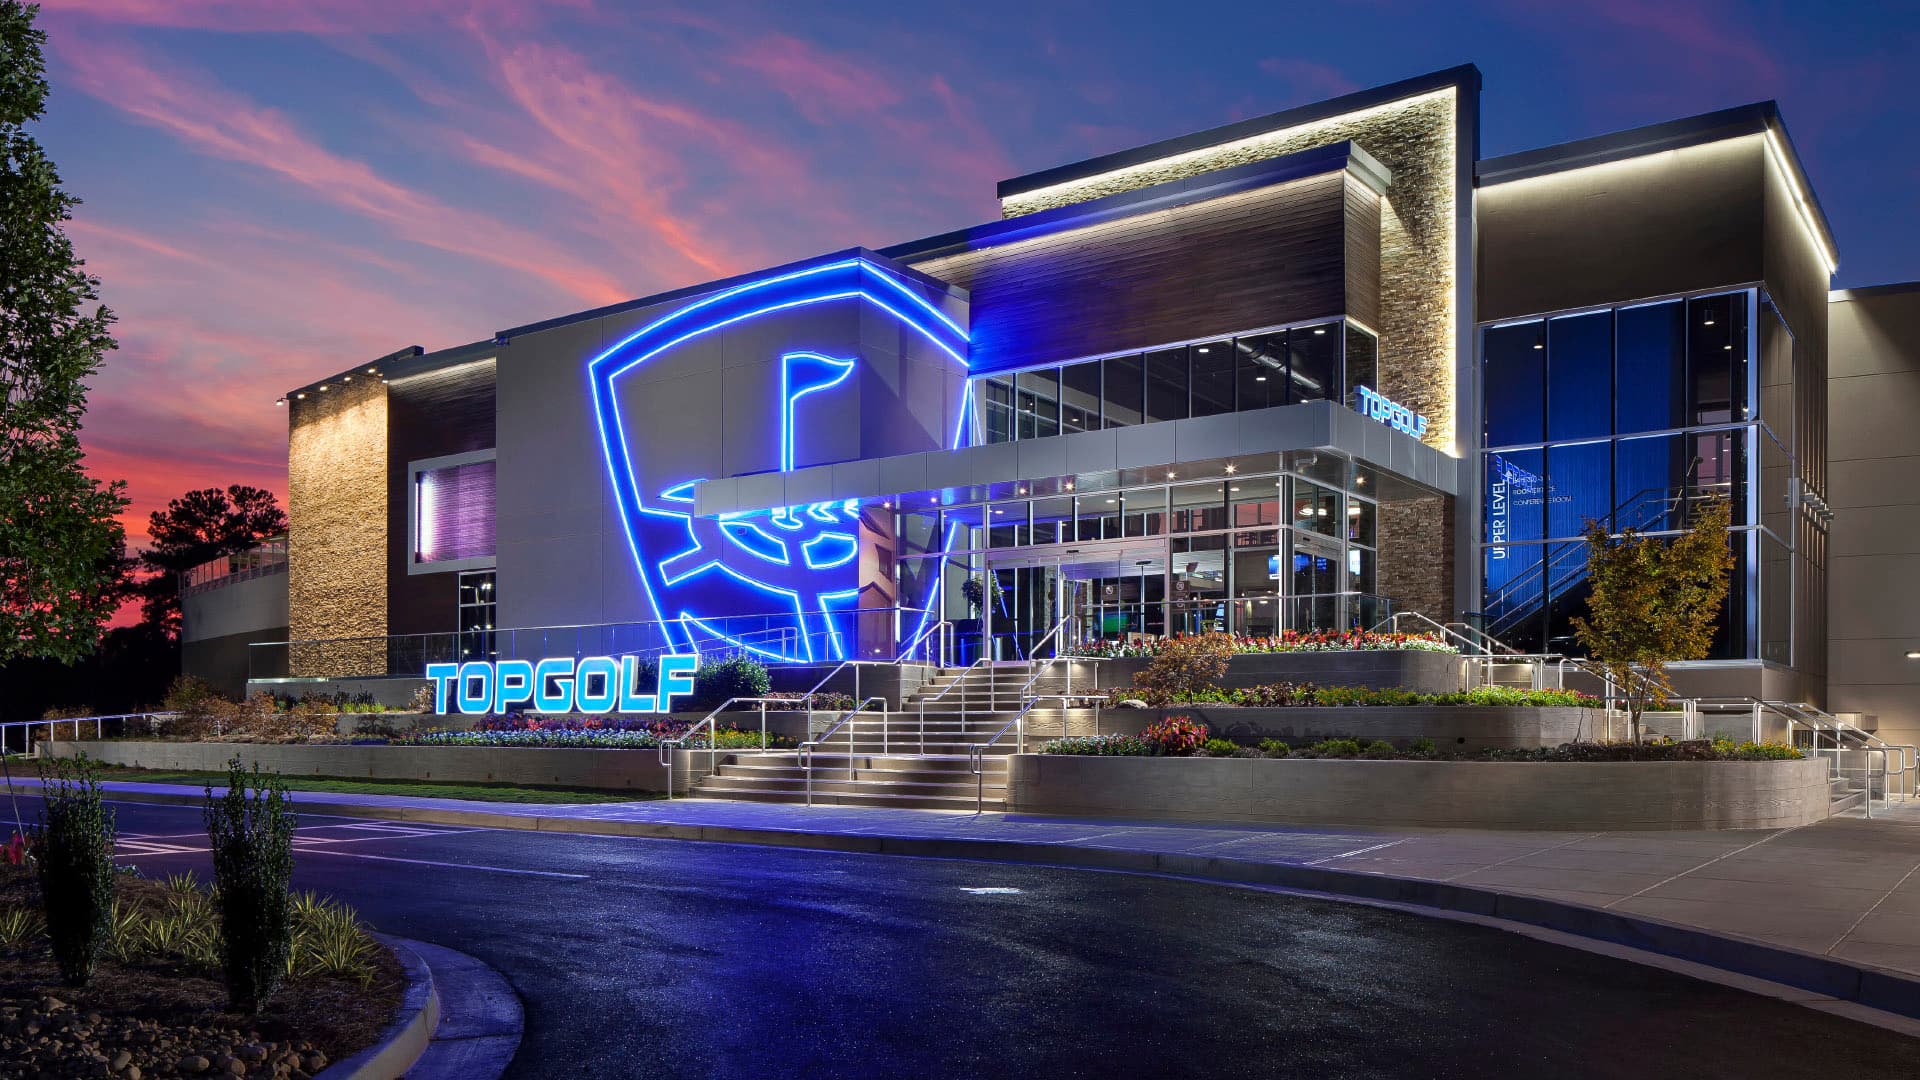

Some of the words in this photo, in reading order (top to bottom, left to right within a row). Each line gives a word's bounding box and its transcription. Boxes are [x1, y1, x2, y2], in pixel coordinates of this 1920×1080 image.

[1358, 384, 1428, 441] TOPGOLF
[1493, 478, 1505, 516] LEVEL
[1493, 519, 1505, 560] UPPER
[426, 654, 700, 715] TOPGOLF
